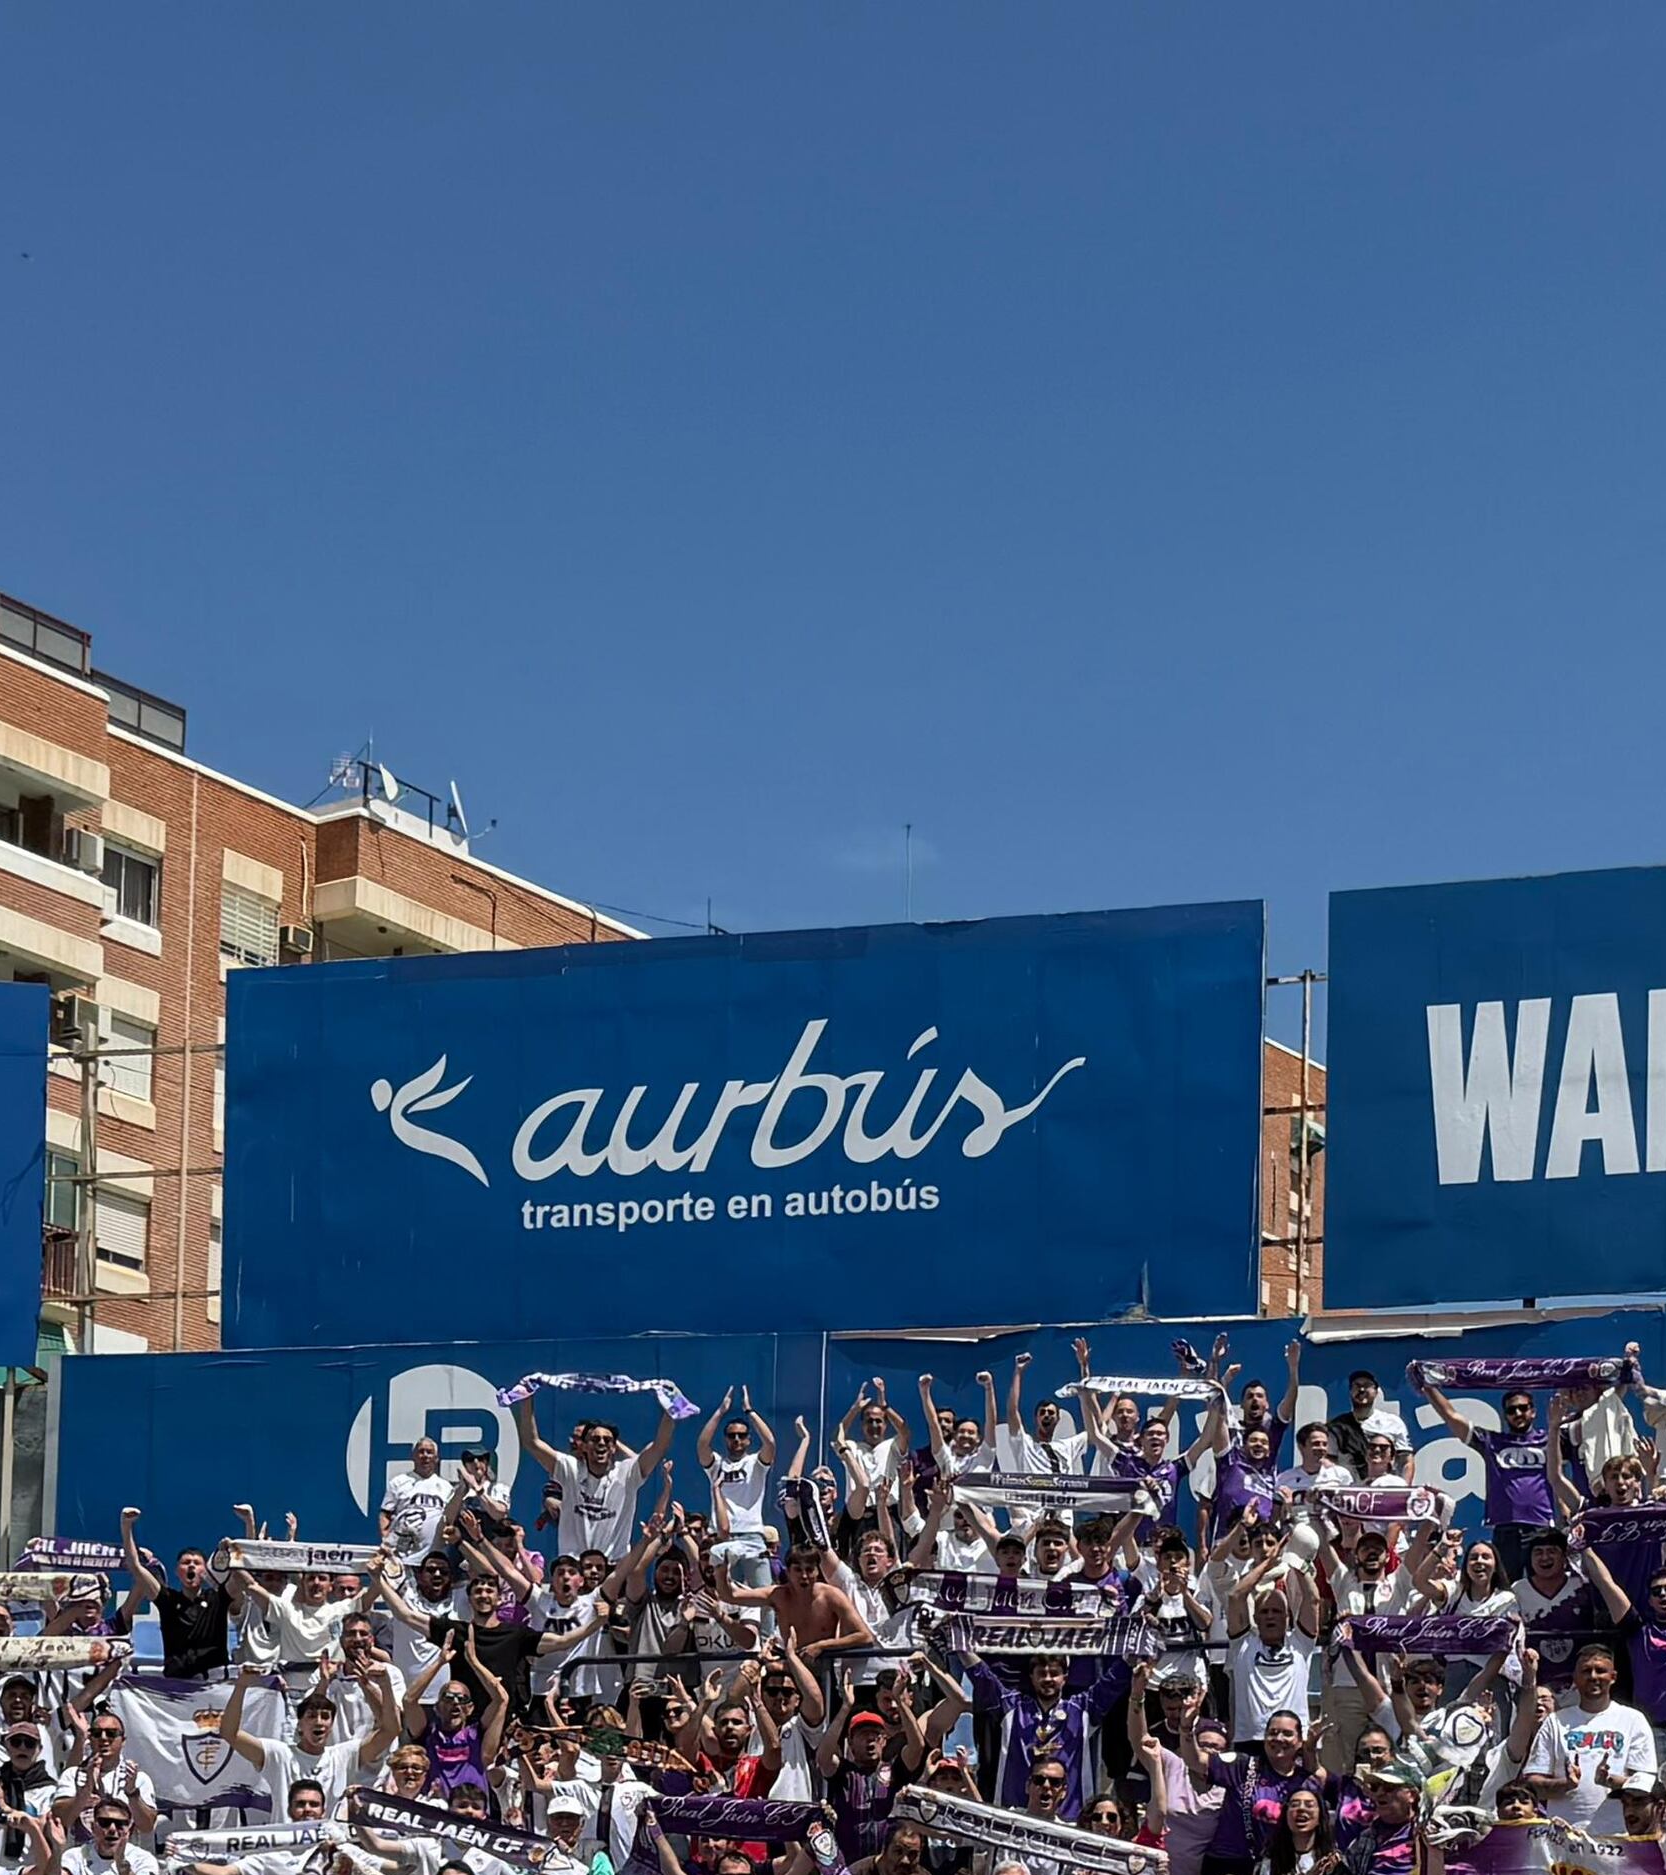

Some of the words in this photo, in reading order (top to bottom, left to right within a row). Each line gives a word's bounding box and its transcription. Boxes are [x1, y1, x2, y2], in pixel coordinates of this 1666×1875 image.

[512, 1018, 1085, 1181] aurbús
[522, 1191, 715, 1232] transporte
[727, 1194, 772, 1219] en
[784, 1178, 939, 1216] autobús
[368, 1801, 423, 1827] REAL
[430, 1819, 491, 1849] JAÉN
[491, 1836, 525, 1855] CF
[659, 1795, 709, 1821] Real
[225, 1829, 283, 1853] REAL
